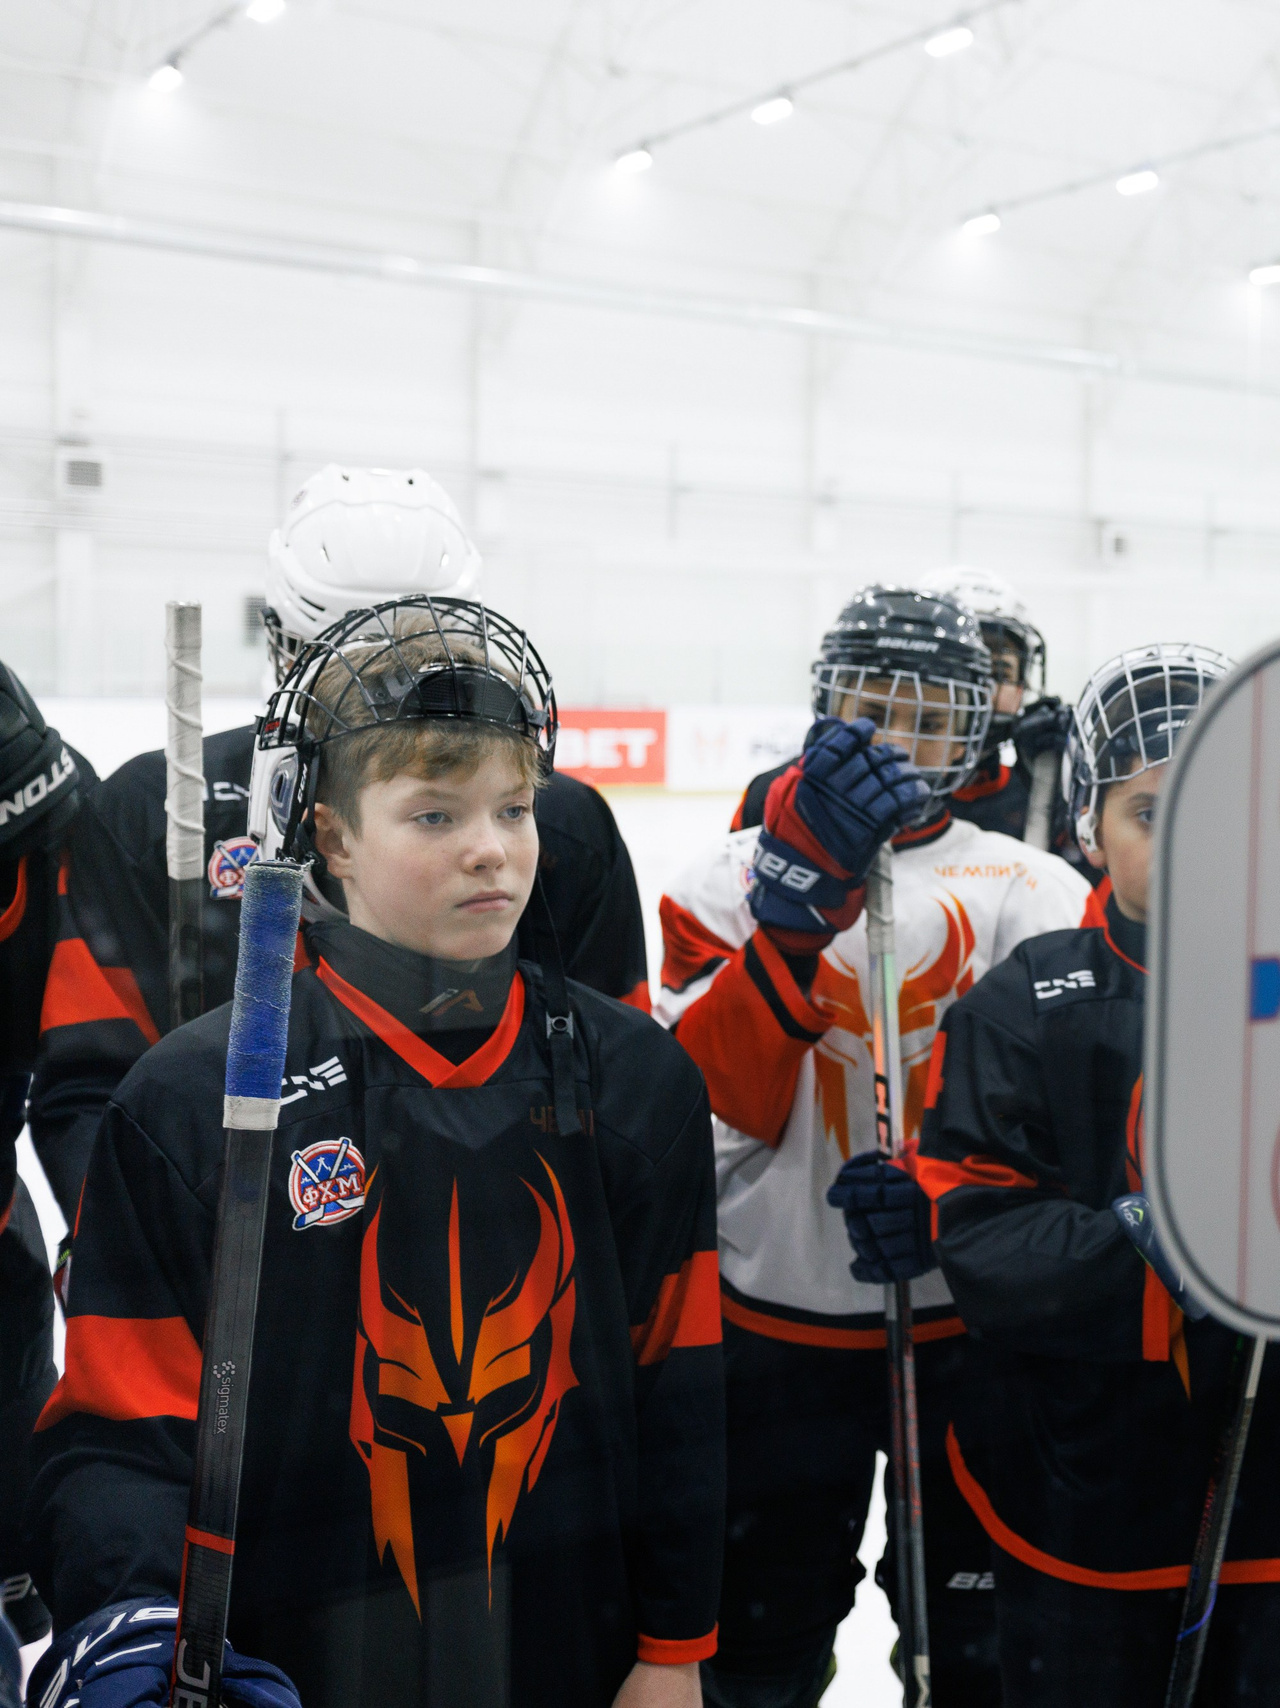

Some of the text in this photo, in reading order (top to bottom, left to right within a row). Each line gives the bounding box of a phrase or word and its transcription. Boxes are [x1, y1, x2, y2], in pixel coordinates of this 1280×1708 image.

[934, 861, 1038, 891] ЧЕМПИОН
[302, 1173, 363, 1207] ФХМ
[216, 1377, 234, 1435] sigmatex
